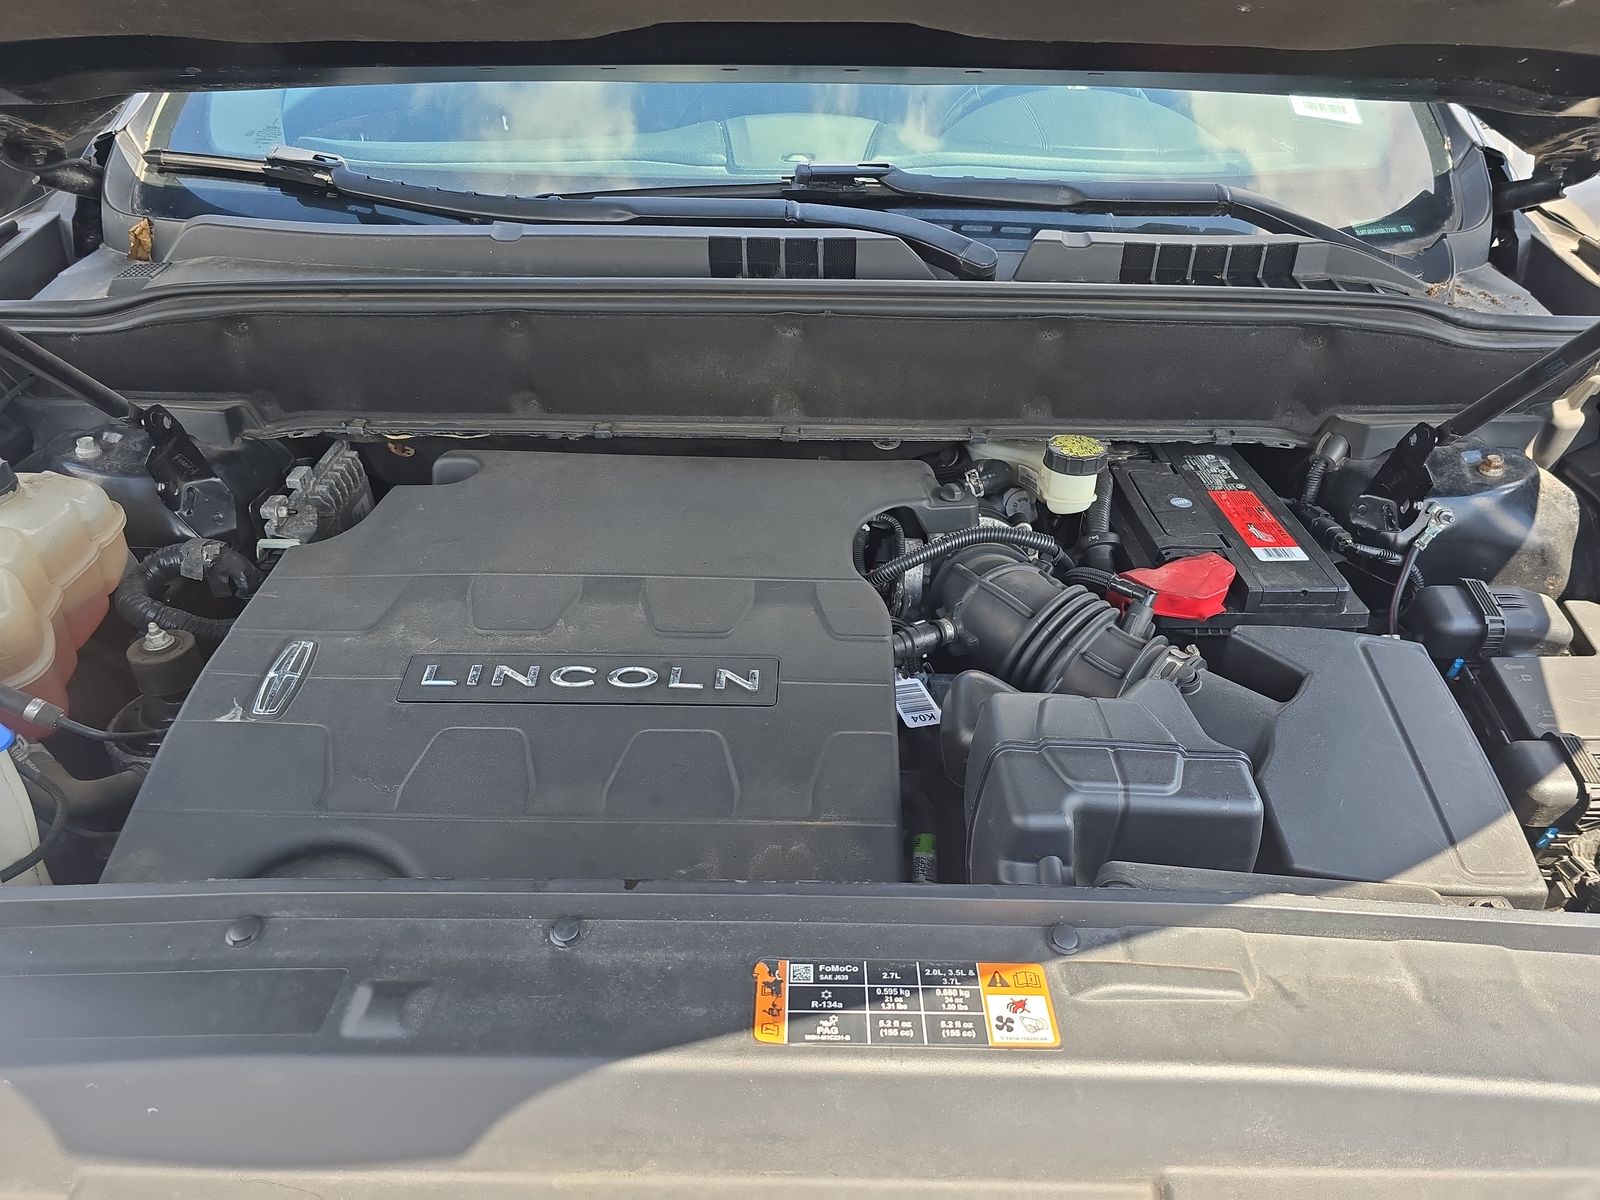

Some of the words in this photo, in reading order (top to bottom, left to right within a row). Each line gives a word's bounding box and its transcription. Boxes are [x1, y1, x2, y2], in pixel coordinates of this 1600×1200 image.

[420, 664, 760, 692] LINCOLN
[910, 713, 937, 723] K04
[818, 964, 859, 973] FoMoCo
[924, 968, 947, 977] 2.0L,
[881, 971, 901, 980] 2.7L
[942, 977, 962, 985] 3.7L
[876, 987, 899, 996] 0.595
[899, 988, 911, 997] kg
[935, 988, 958, 997] 0.680
[959, 989, 971, 998] kg
[811, 1000, 844, 1009] R-134a
[816, 1026, 839, 1035] PAG
[899, 1029, 914, 1037] cc)
[961, 1030, 977, 1038] cc)
